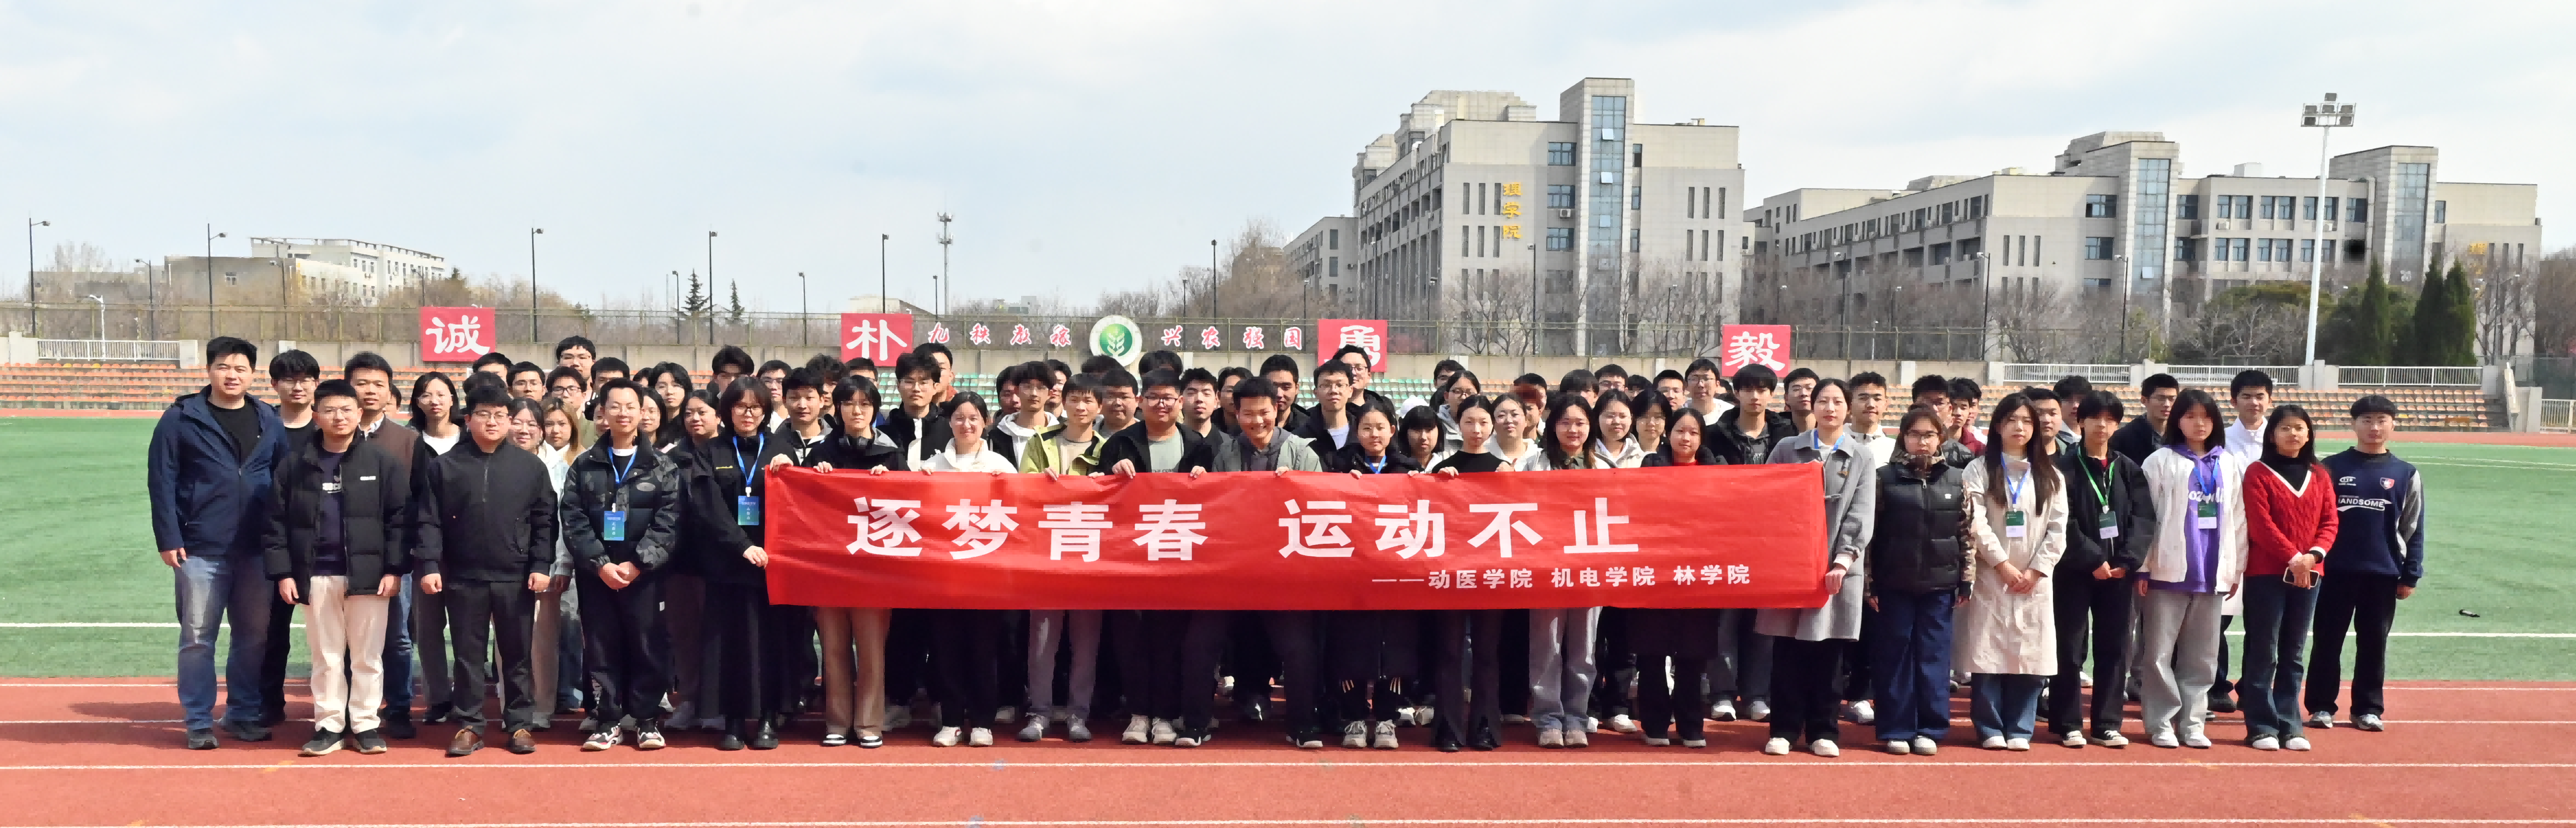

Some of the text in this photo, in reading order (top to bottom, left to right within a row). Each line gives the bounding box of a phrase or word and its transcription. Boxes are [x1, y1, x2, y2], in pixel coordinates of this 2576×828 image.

[1502, 181, 1523, 239] 理学院
[426, 315, 490, 355] 诚
[846, 320, 908, 361] 朴
[1161, 325, 1302, 350] 兴农强国
[1725, 331, 1785, 371] 毅
[846, 497, 1639, 562] 逐梦青春 运动不止
[1551, 566, 1655, 588] 机电学院
[1673, 564, 1750, 585] 林学院
